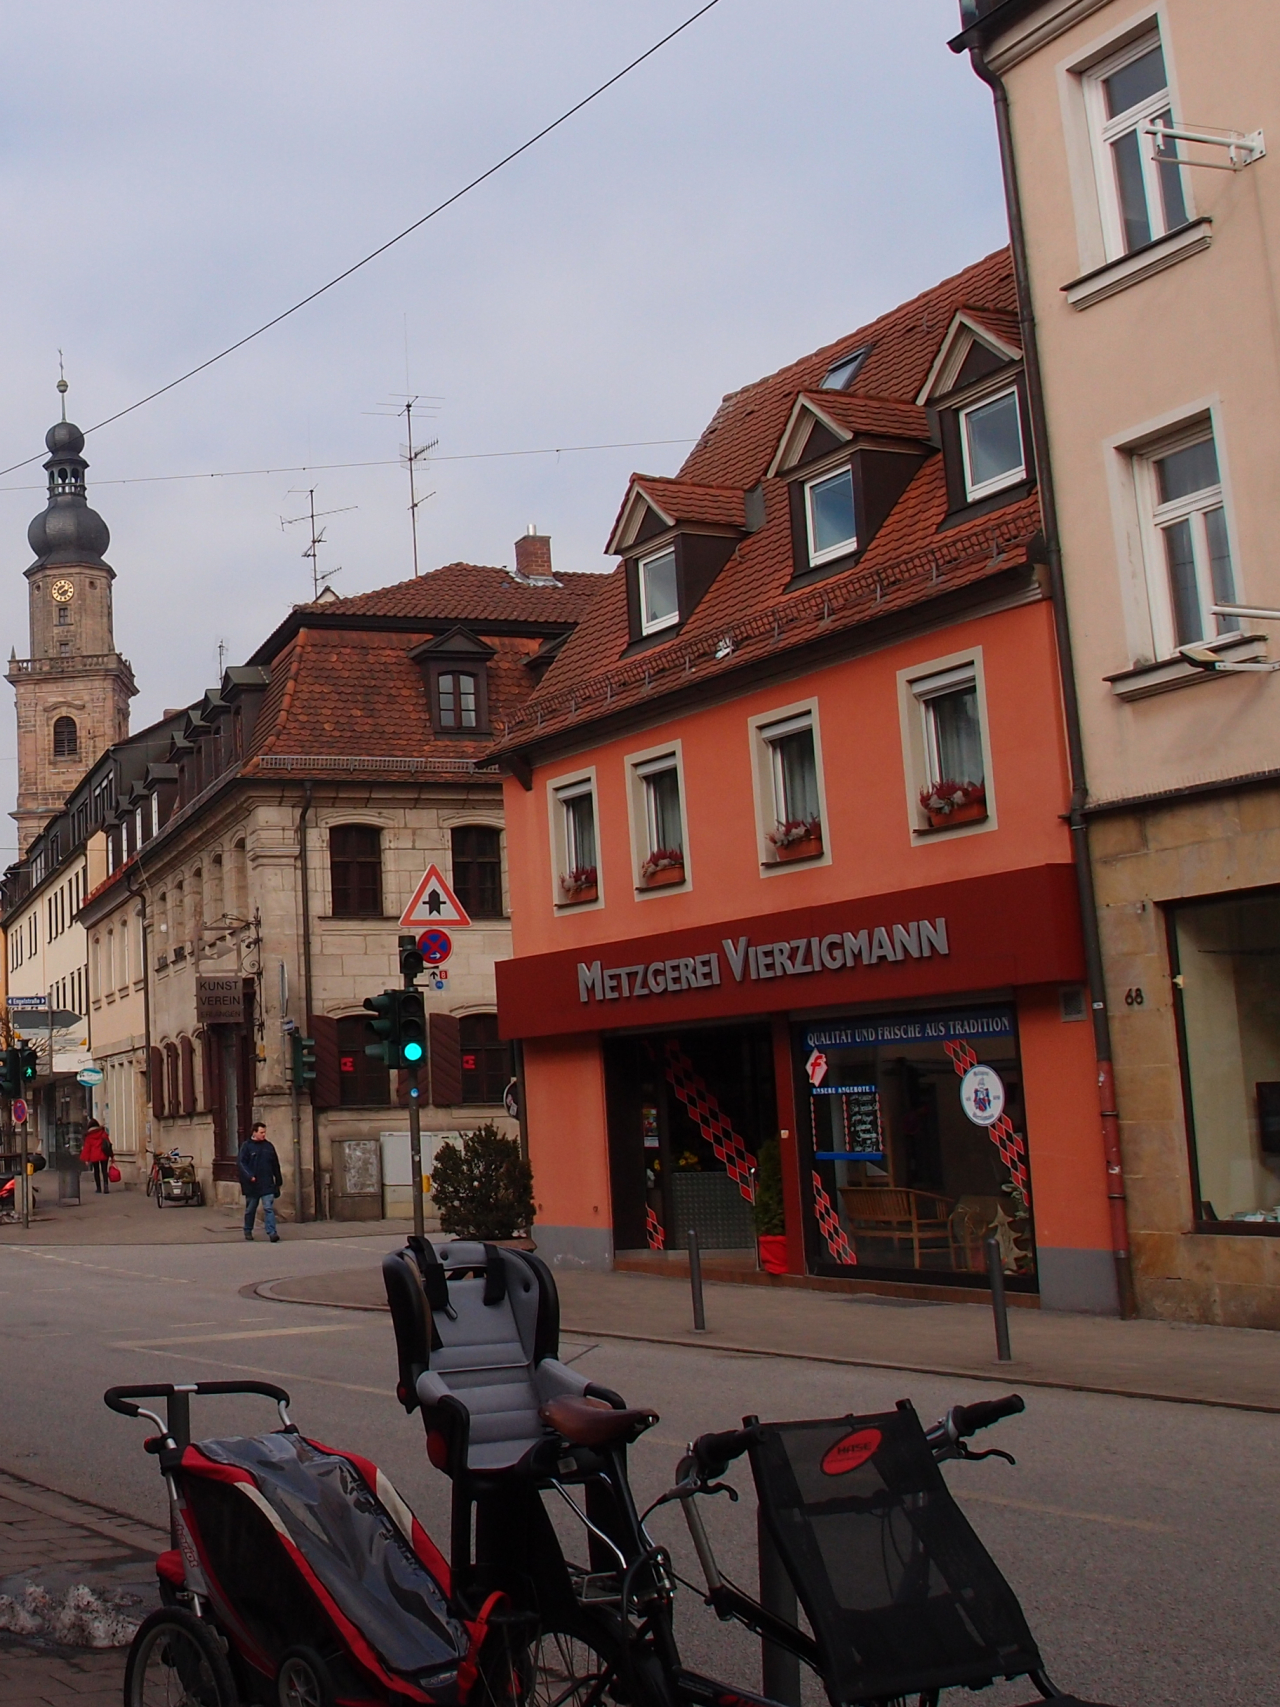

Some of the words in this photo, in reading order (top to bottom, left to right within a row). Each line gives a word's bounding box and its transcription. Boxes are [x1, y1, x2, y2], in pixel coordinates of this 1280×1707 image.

[577, 953, 721, 1003] METZGEREI
[722, 917, 950, 982] VIERZIGMANN
[200, 980, 238, 991] KUNST
[200, 996, 241, 1006] VEREIN
[1125, 987, 1144, 1005] 68
[200, 1010, 241, 1018] ERLANGEN
[807, 1026, 852, 1046] QUALITÄT
[855, 1027, 876, 1043] UND
[878, 1023, 921, 1040] FRISCHE
[925, 1021, 945, 1037] AUS
[948, 1016, 1010, 1035] TRADITION
[837, 1085, 870, 1094] ANGEBOTE
[837, 1442, 871, 1455] HASE
